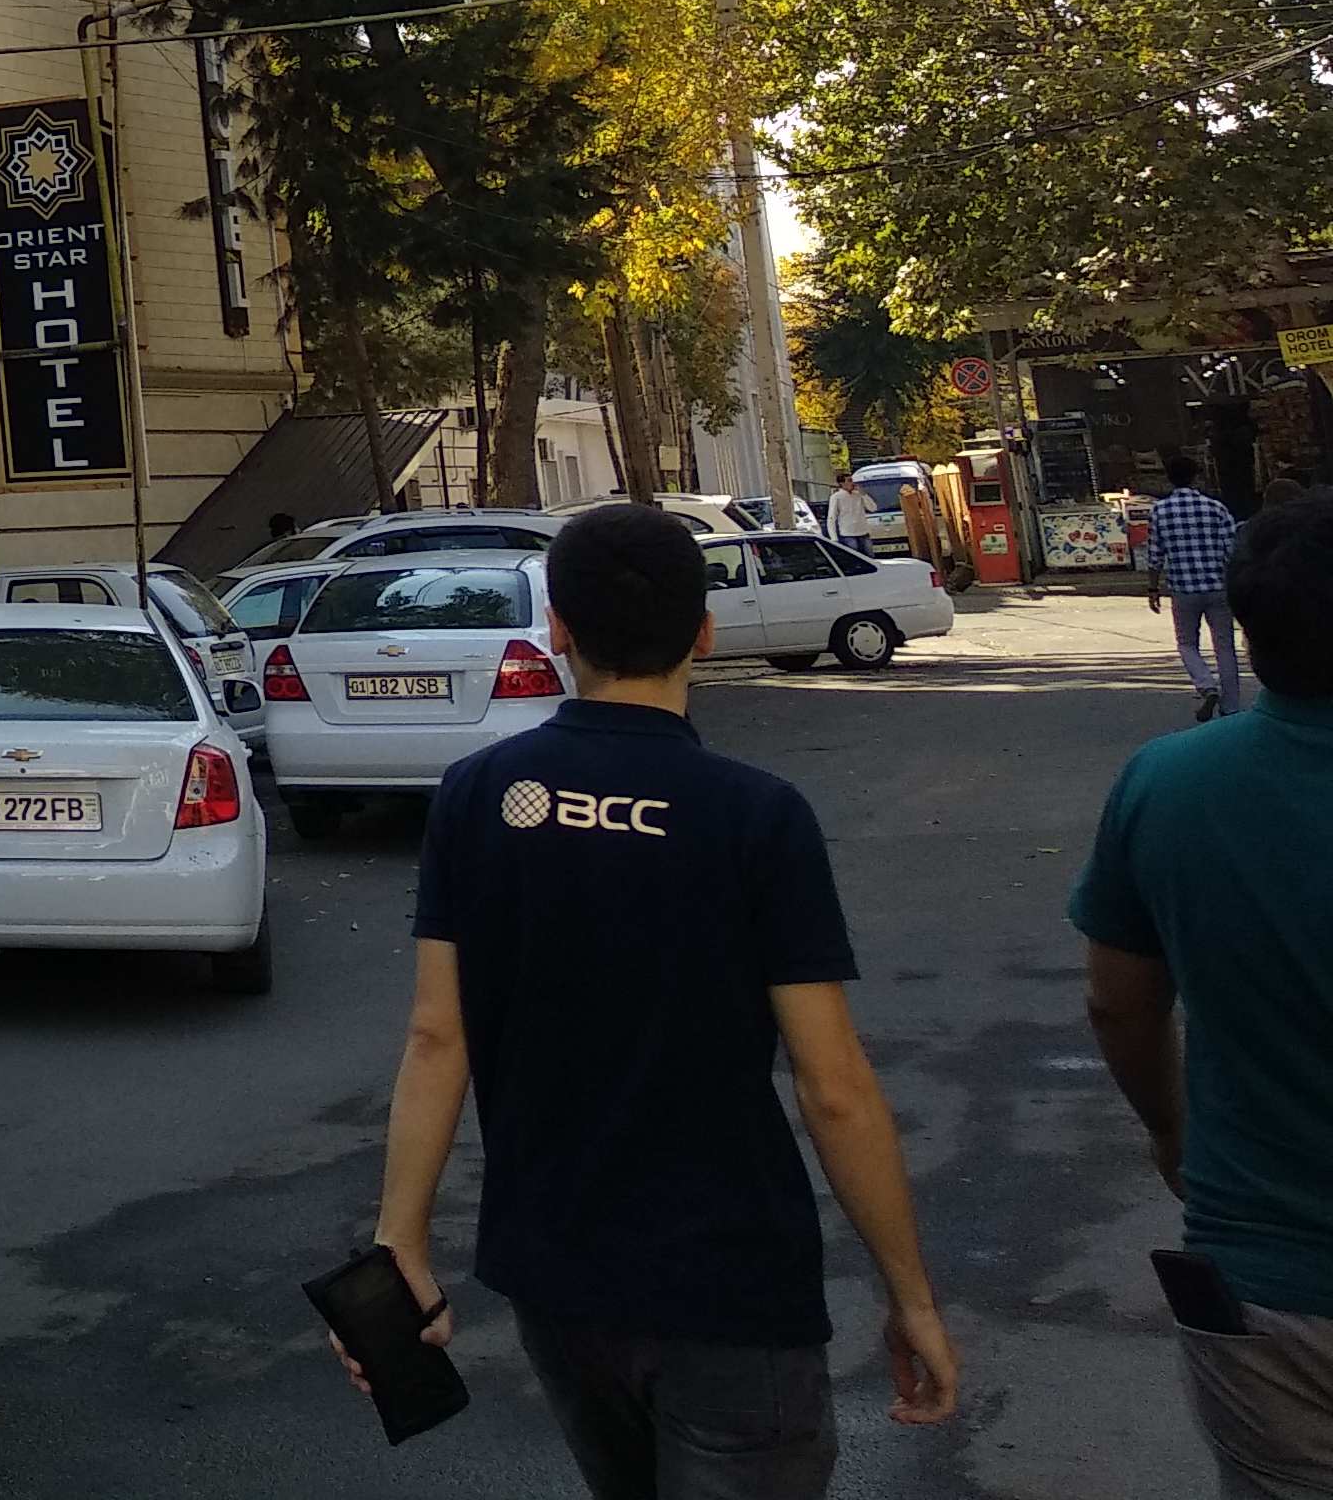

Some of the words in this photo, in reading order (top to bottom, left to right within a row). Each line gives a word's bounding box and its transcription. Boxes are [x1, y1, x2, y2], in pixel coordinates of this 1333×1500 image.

[14, 248, 88, 271] STAR
[1285, 328, 1329, 343] OROM
[1288, 340, 1333, 355] HOTEL
[32, 278, 89, 468] HOTEL
[351, 681, 367, 694] 01
[369, 678, 399, 695] 182
[403, 678, 439, 695] VSB
[555, 790, 670, 837] BCC
